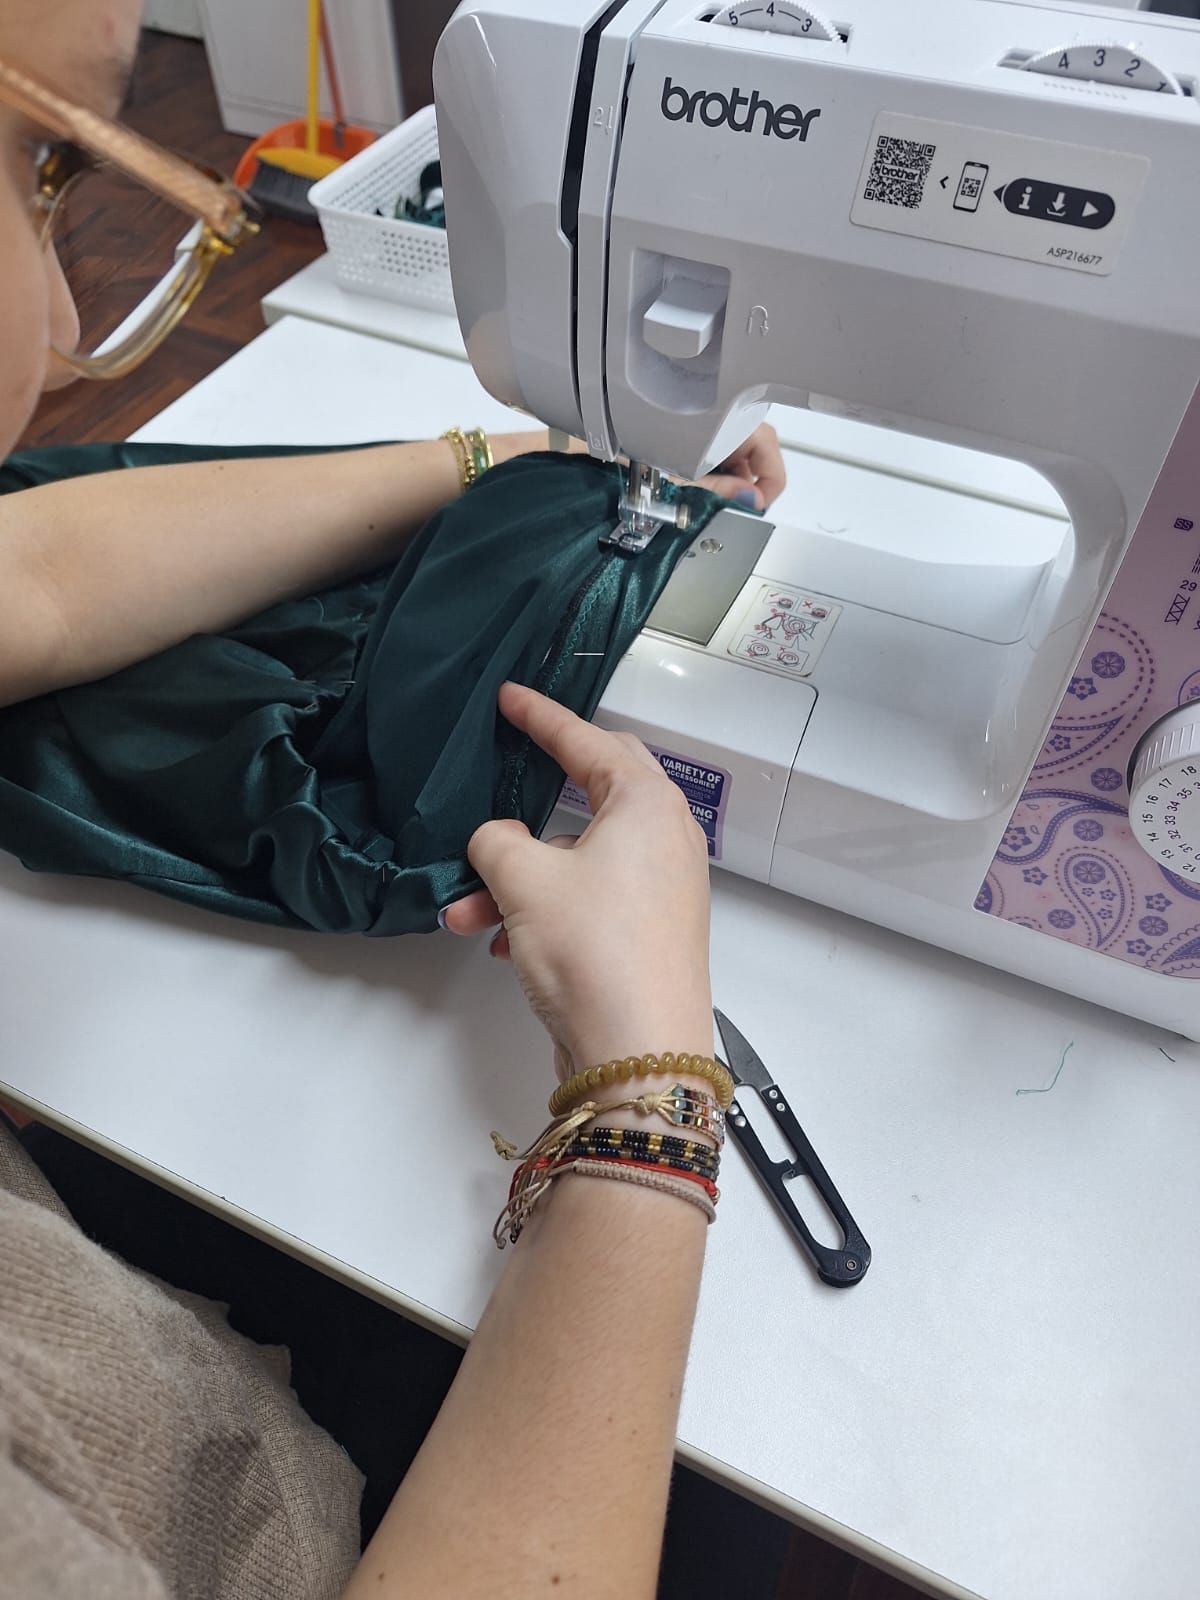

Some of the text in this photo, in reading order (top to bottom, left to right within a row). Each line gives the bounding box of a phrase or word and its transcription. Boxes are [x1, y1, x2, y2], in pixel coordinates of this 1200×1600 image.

[729, 2, 812, 32] 5 4 3
[1058, 52, 1069, 69] 4
[1094, 49, 1106, 67] 3
[1124, 59, 1141, 77] 2
[661, 76, 822, 142] brother
[881, 165, 919, 180] brother
[1179, 579, 1197, 591] 29
[662, 757, 722, 784] VARIETY OF
[1181, 765, 1197, 776] 18
[1158, 778, 1172, 789] 17
[1177, 787, 1192, 799] 35
[1146, 794, 1159, 804] 16
[1166, 801, 1180, 812] 34
[1142, 813, 1154, 823] 15
[1165, 815, 1176, 825] 33
[1147, 832, 1160, 842] 14
[1168, 829, 1181, 840] 32
[1178, 843, 1193, 853] 31
[1161, 849, 1175, 859] 13
[1182, 863, 1196, 873] 12
